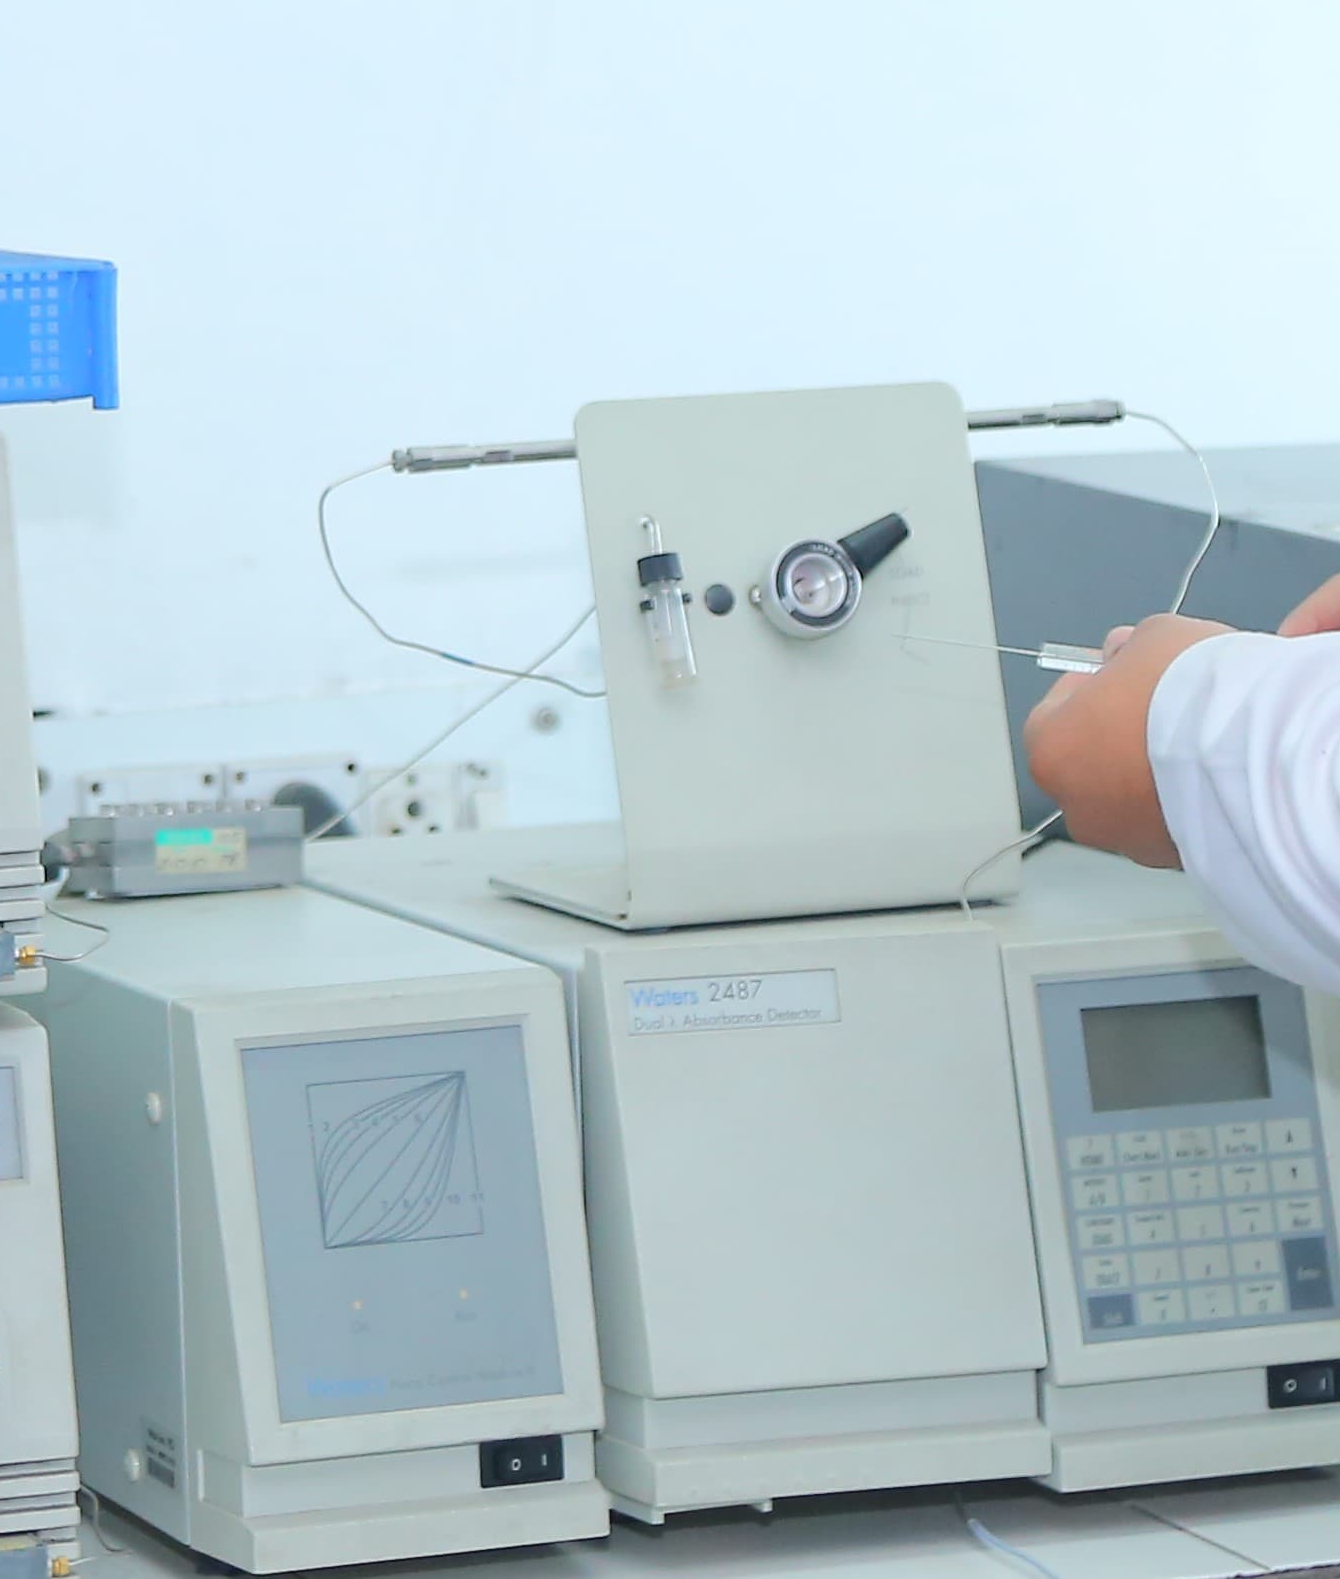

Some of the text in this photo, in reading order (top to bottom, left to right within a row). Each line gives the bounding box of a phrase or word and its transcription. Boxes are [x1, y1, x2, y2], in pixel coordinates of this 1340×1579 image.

[629, 979, 764, 1009] Waters 2487
[682, 1010, 764, 1028] Absorbance
[766, 1007, 823, 1022] Detector
